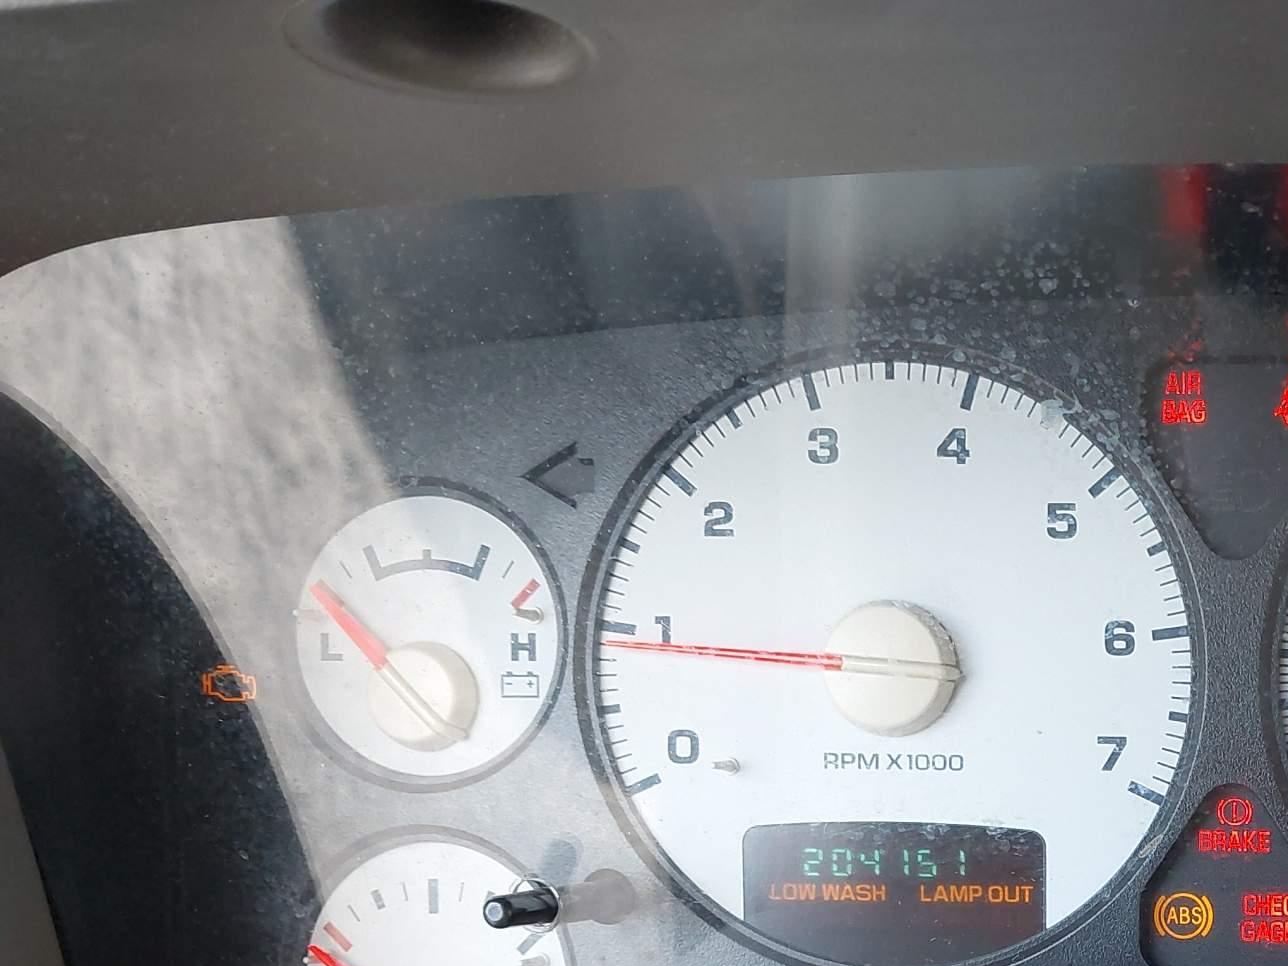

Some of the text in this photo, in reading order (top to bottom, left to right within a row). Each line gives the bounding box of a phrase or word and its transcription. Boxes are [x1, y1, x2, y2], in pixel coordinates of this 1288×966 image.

[1165, 371, 1202, 395] AIR
[1161, 400, 1206, 423] BAG
[808, 428, 838, 464] 3
[937, 428, 970, 464] 4
[704, 502, 734, 536] 2
[1046, 503, 1077, 538] 5
[655, 616, 672, 644] 1
[1104, 620, 1136, 656] 6
[321, 633, 343, 660] L
[511, 633, 537, 661] H
[668, 730, 700, 764] 0
[1097, 736, 1128, 771] 7
[824, 753, 881, 771] RPM
[1199, 831, 1270, 852] BRAKE
[804, 848, 966, 877] 204151
[769, 884, 886, 901] LOW WASH
[920, 886, 1033, 903] LAMP OUT
[1167, 907, 1201, 924] ABS
